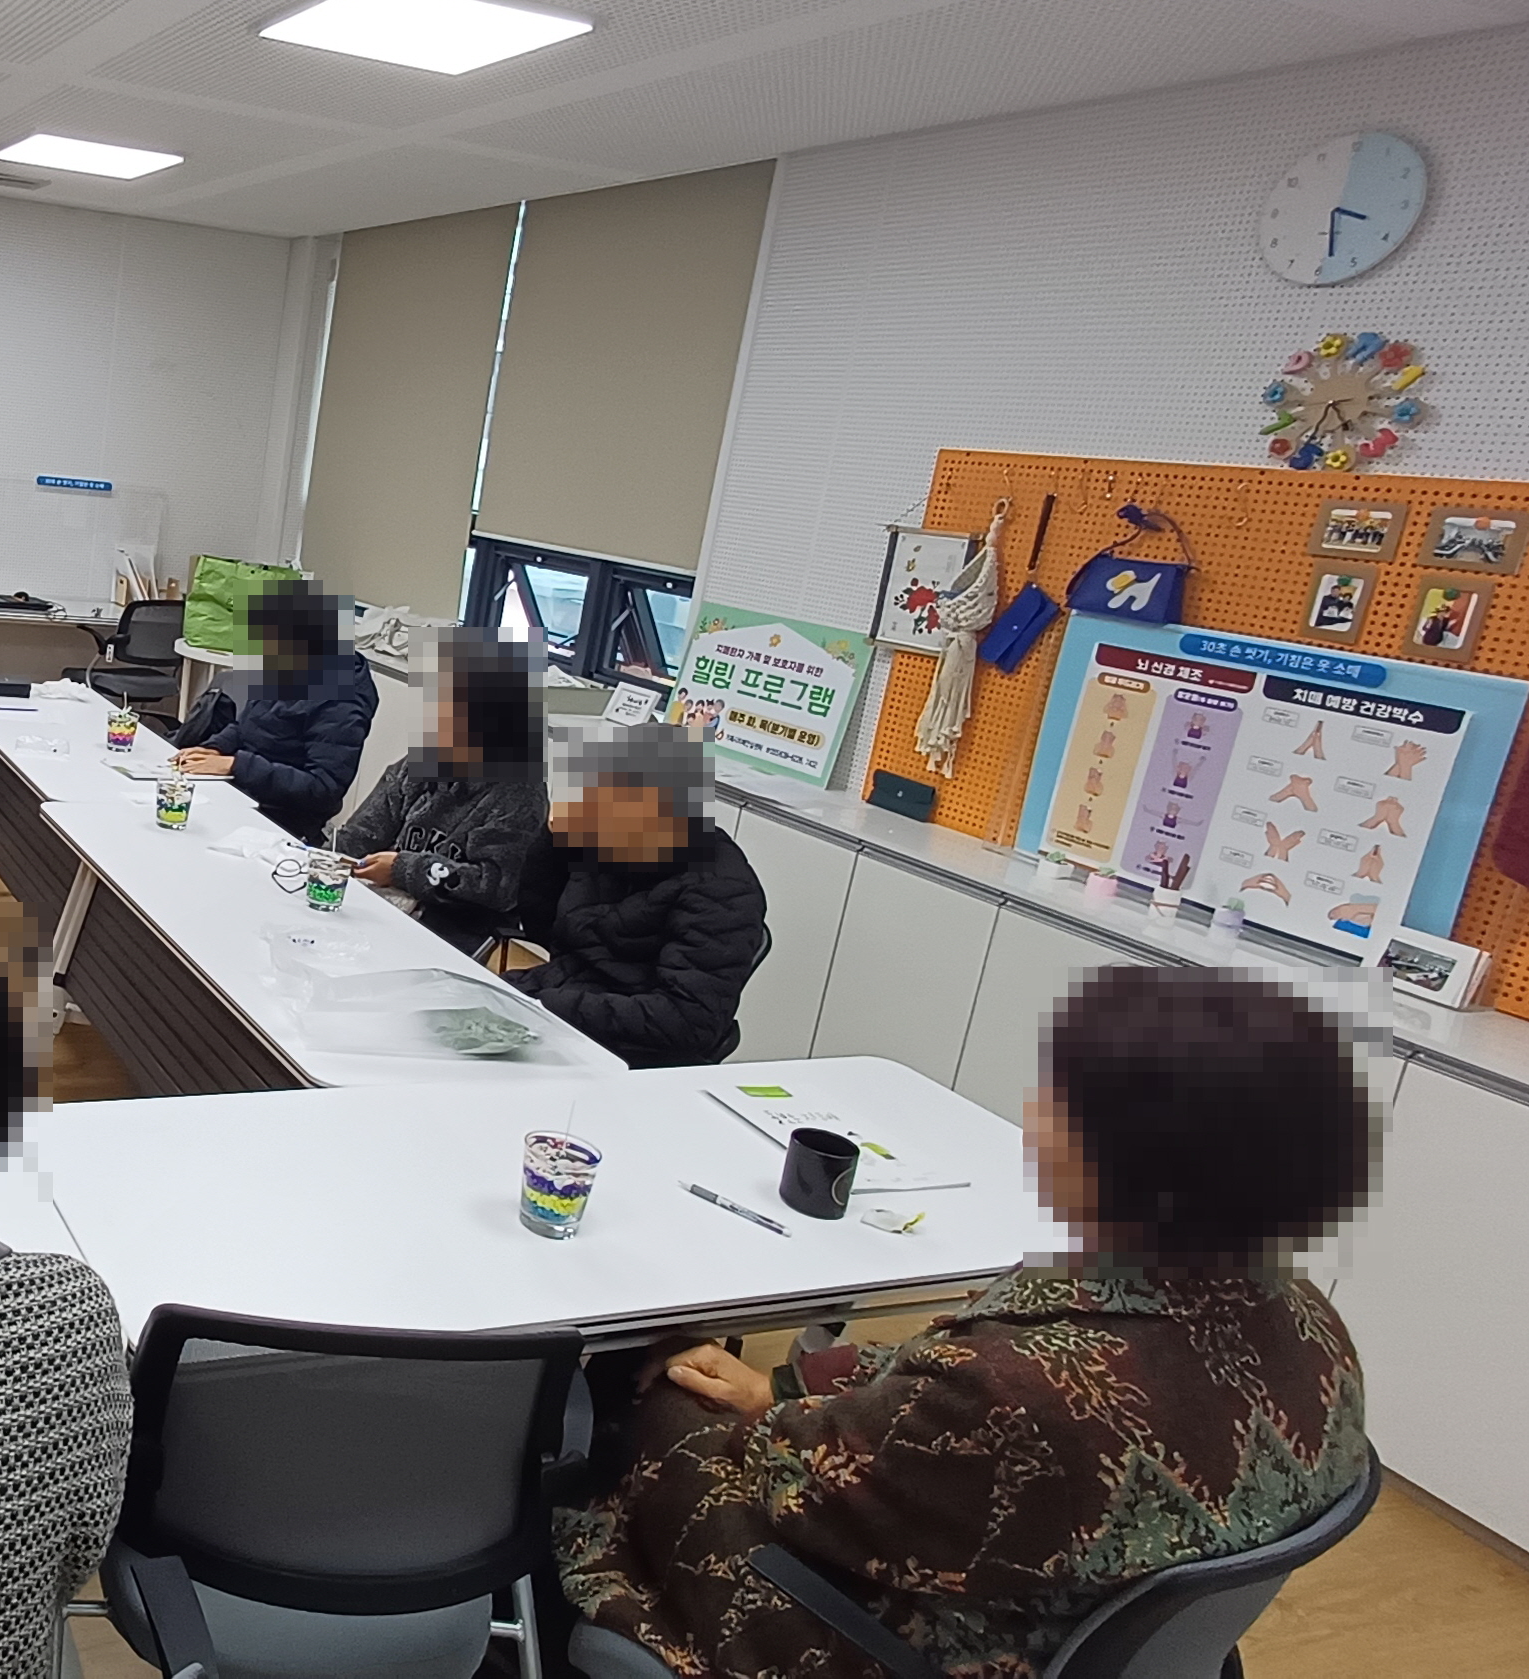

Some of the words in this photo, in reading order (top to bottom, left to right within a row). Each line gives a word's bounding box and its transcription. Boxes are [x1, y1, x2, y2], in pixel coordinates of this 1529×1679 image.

[1200, 640, 1227, 655] 30초
[1229, 646, 1242, 658] 손
[772, 657, 805, 674] 보호자를
[806, 665, 824, 678] 위한
[1135, 657, 1149, 671] 뇌
[1150, 662, 1176, 676] 신경
[1176, 666, 1204, 682] 체조
[691, 655, 736, 690] 힐링
[737, 668, 836, 718] 프로그램
[1292, 687, 1324, 706] 치매
[1325, 694, 1358, 713] 예방
[1359, 701, 1425, 725] 건강박수
